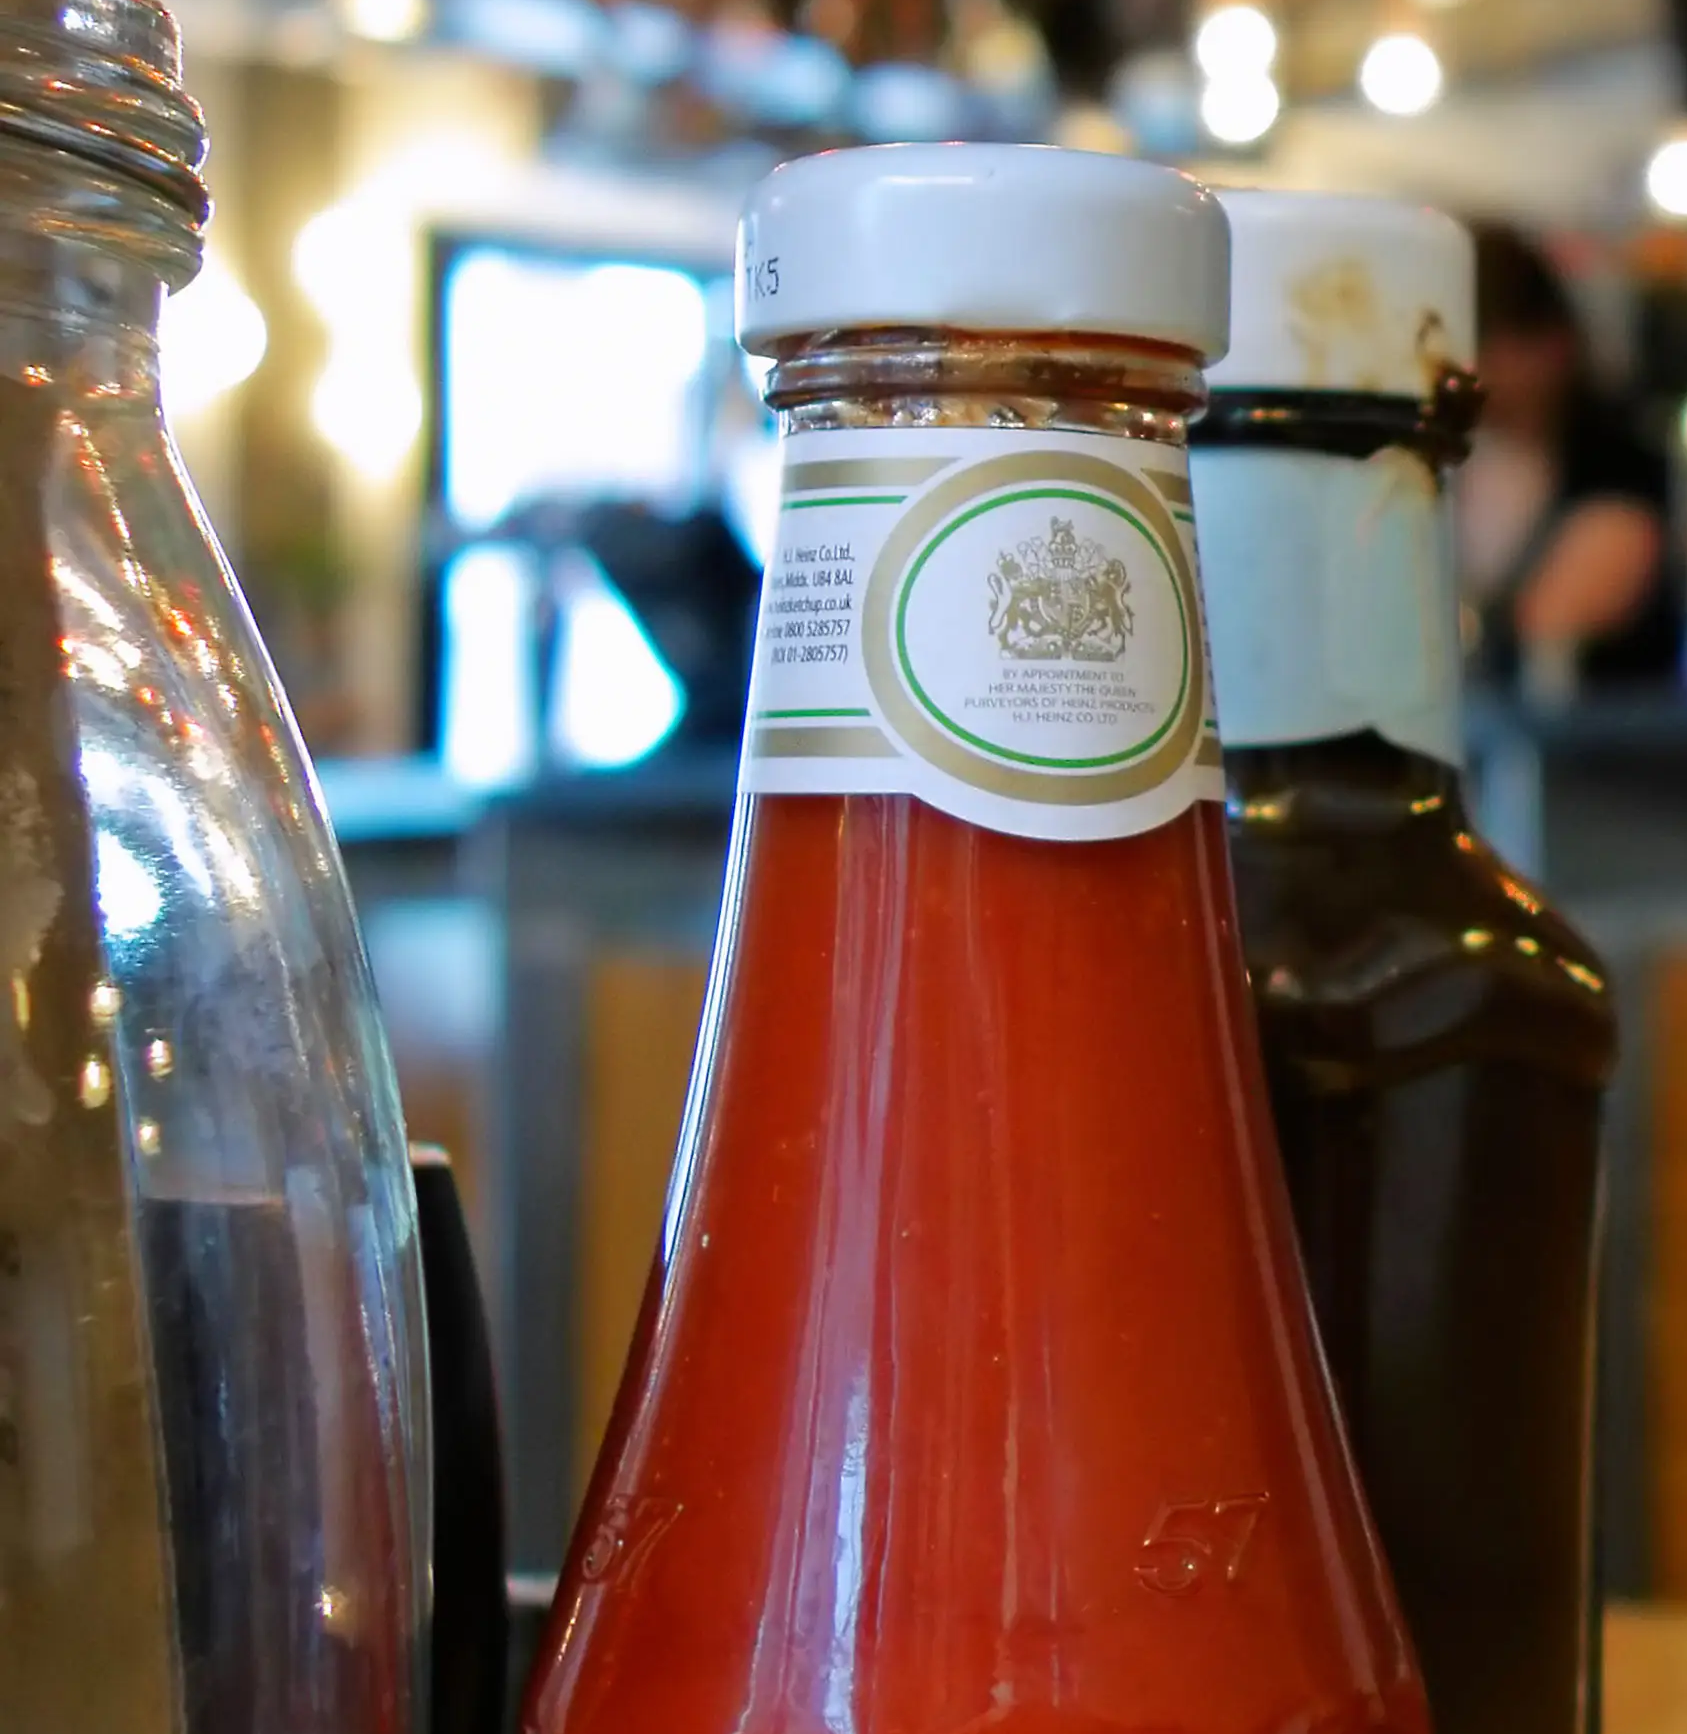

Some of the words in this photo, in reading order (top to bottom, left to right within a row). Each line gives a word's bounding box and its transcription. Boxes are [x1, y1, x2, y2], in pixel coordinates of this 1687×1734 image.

[1022, 669, 1108, 682] APPOINTMENT
[989, 683, 1014, 695] HER
[1015, 683, 1072, 695] MAJESTY
[1075, 683, 1098, 695] THE
[1099, 685, 1136, 698] QUEEN
[964, 697, 1039, 709] PURVEYORS
[1041, 697, 1057, 709] OF
[1061, 698, 1098, 710] HEINZ
[1035, 712, 1073, 724] HEINZ
[1075, 712, 1093, 724] CO
[1097, 713, 1118, 725] LTD
